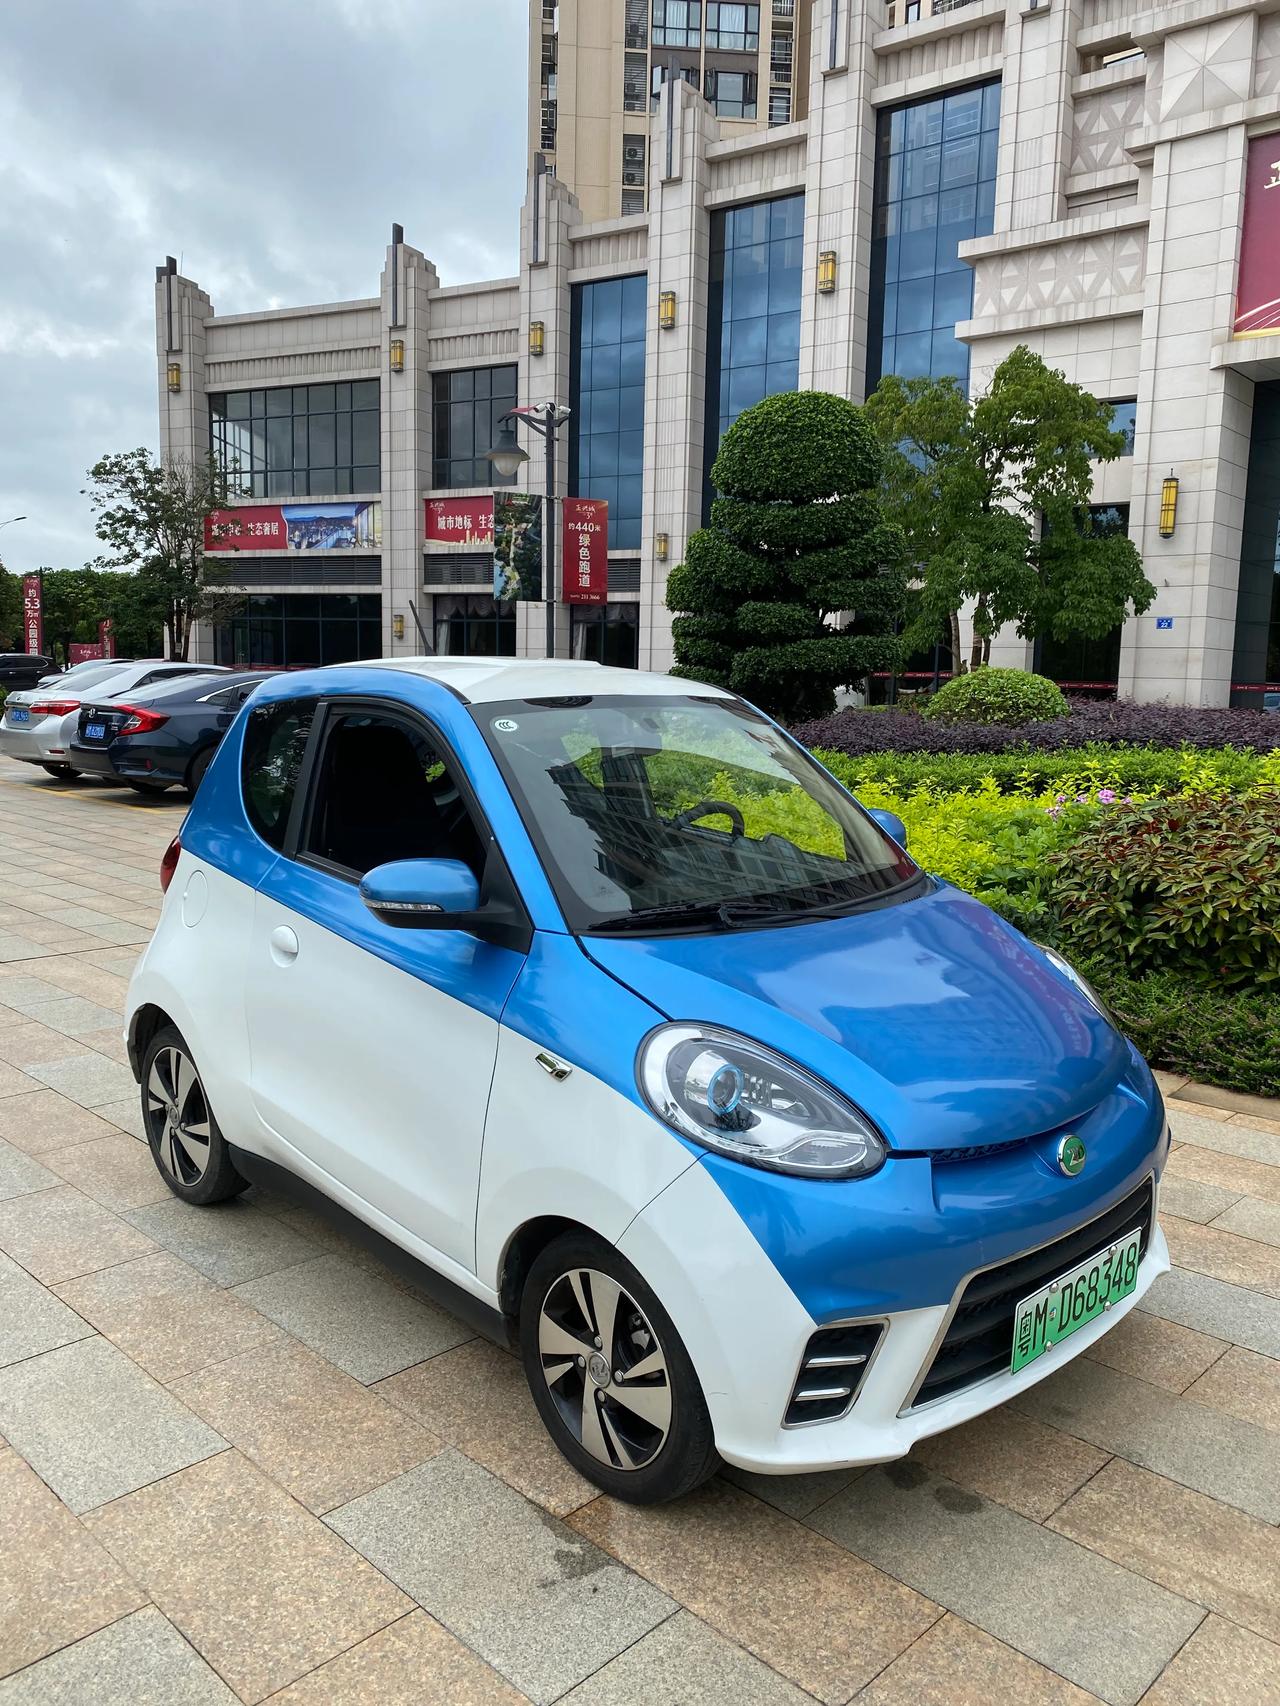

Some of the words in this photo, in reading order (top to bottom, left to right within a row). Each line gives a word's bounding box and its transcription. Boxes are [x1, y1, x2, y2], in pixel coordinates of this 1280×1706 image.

[438, 515, 472, 530] 城市地标
[579, 533, 591, 587] 绿色跑道
